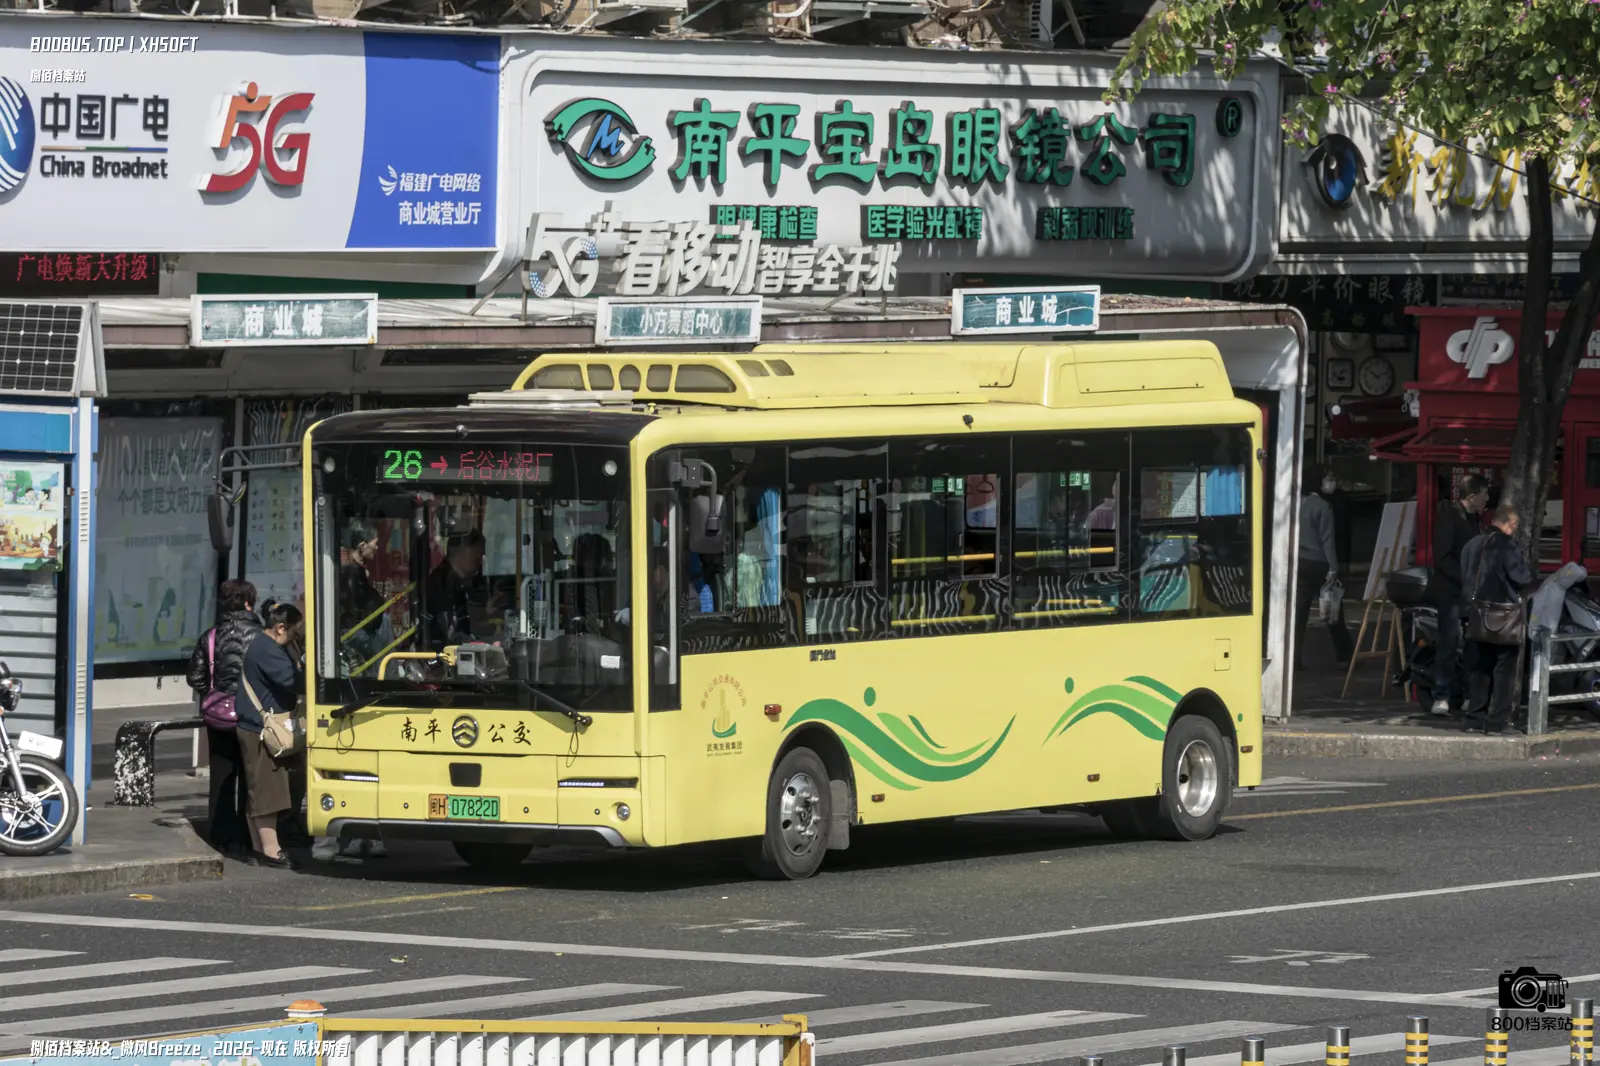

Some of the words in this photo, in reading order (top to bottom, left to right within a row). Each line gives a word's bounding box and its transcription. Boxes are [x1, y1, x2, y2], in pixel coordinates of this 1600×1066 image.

[40, 92, 169, 142] 中国广电
[198, 81, 316, 193] 5G
[668, 97, 1196, 188] 南平宝岛眼镜公司
[40, 155, 85, 178] China
[92, 156, 168, 178] Broadnet
[399, 172, 481, 192] 福建广电网络
[398, 201, 482, 225] 商业城营业厅
[866, 205, 983, 239] 医学验光配镜
[243, 303, 325, 337] 商业城
[640, 307, 724, 335] 小方舞蹈中心
[995, 295, 1059, 325] 商业城
[384, 449, 424, 480] 26
[456, 450, 554, 481] 后谷水泥厂
[400, 716, 442, 744] 南平
[487, 723, 532, 746] 公交
[452, 798, 499, 818] 07822D
